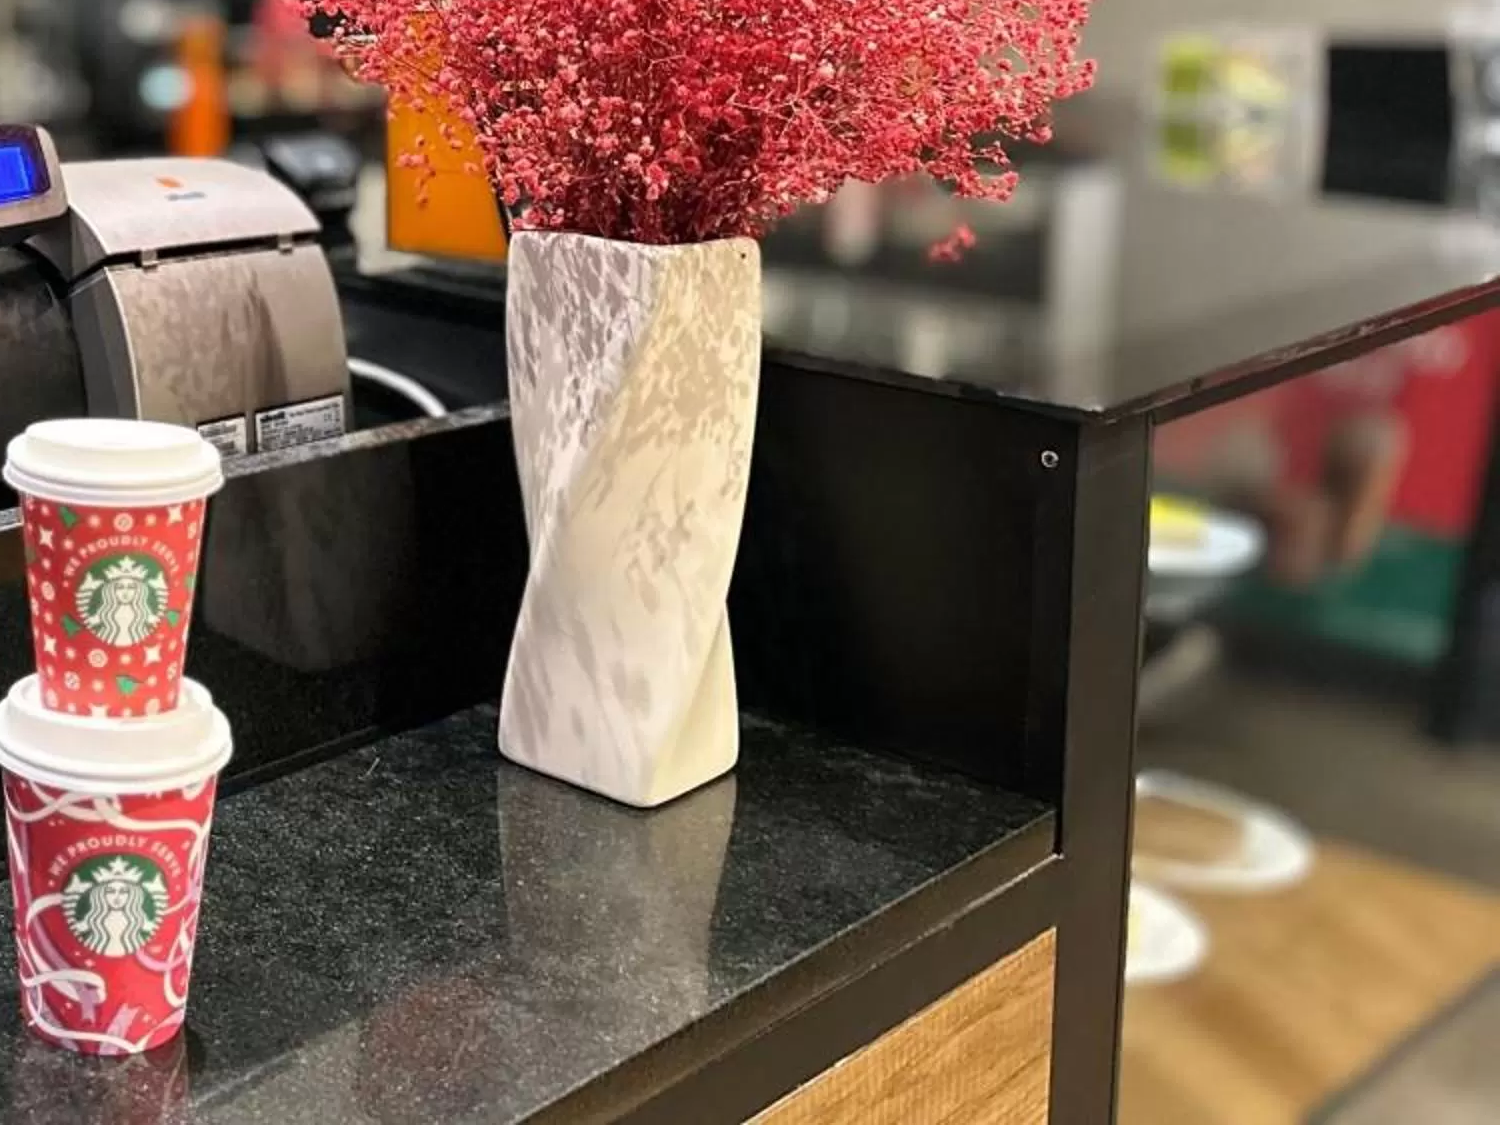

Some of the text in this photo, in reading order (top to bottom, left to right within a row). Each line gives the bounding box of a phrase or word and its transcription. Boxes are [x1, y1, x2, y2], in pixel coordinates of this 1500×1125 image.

[63, 556, 81, 576] WE
[79, 535, 148, 559] PROUDLY
[48, 854, 69, 876] WE
[66, 834, 149, 858] PROUDLY
